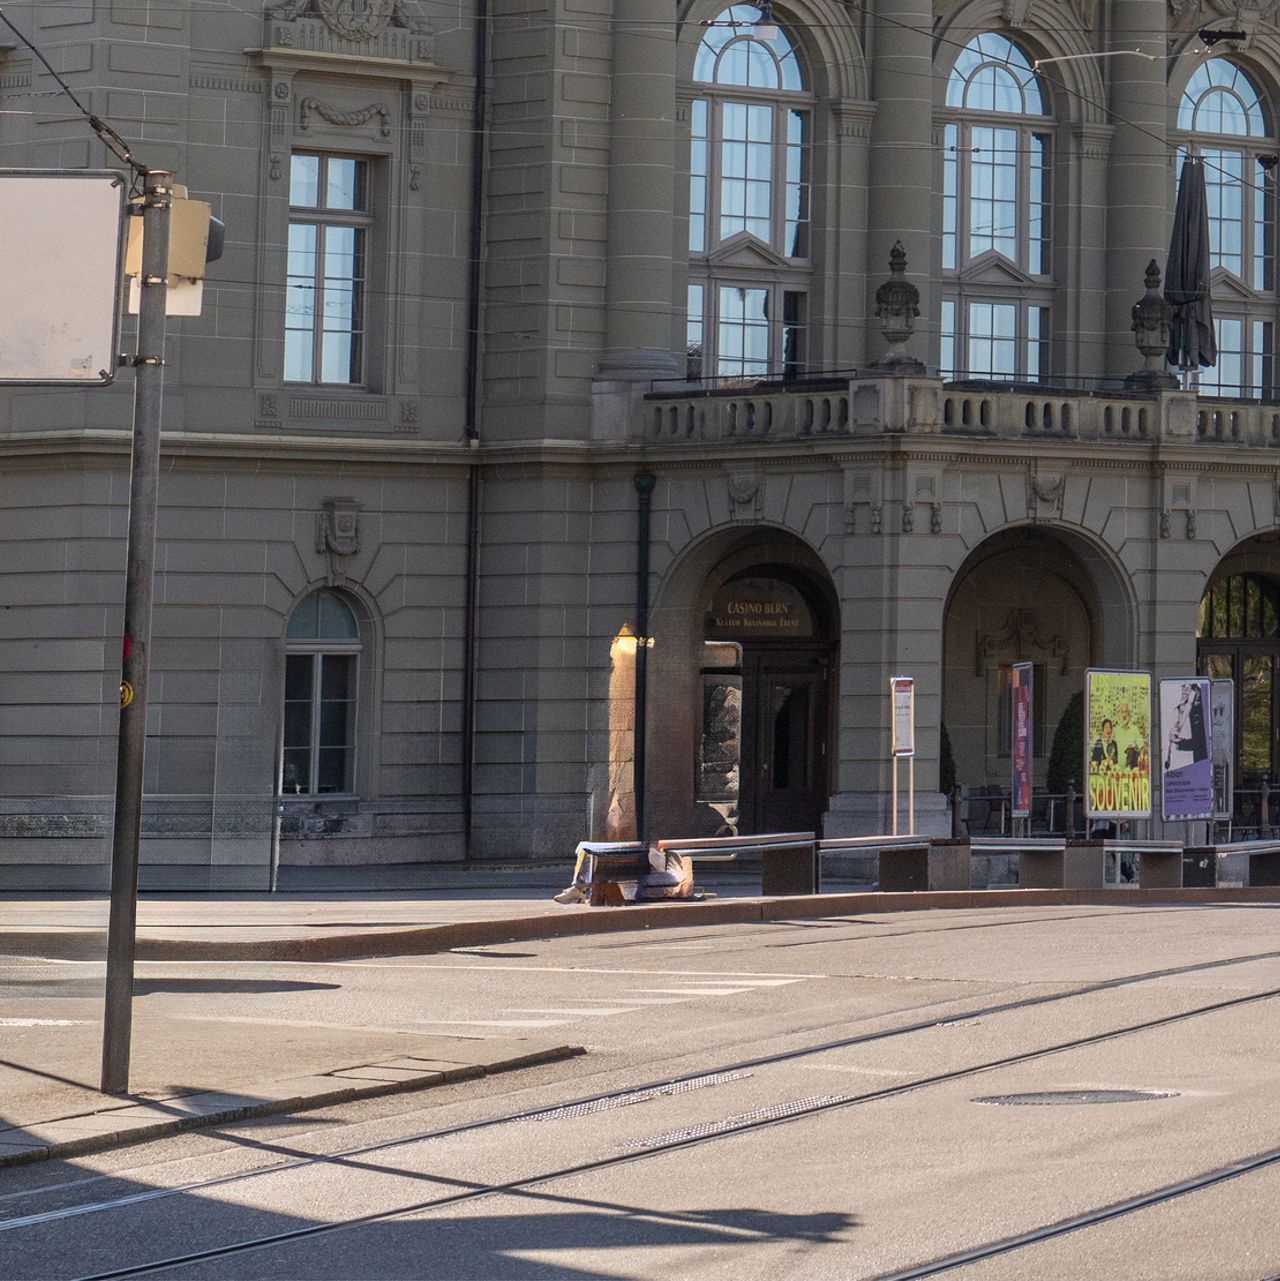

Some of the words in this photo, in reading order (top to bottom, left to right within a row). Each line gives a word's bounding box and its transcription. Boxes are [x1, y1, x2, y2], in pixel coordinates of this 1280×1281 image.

[727, 601, 762, 614] CASINO
[764, 602, 789, 614] BERN
[1089, 775, 1150, 812] SOUVENIR
